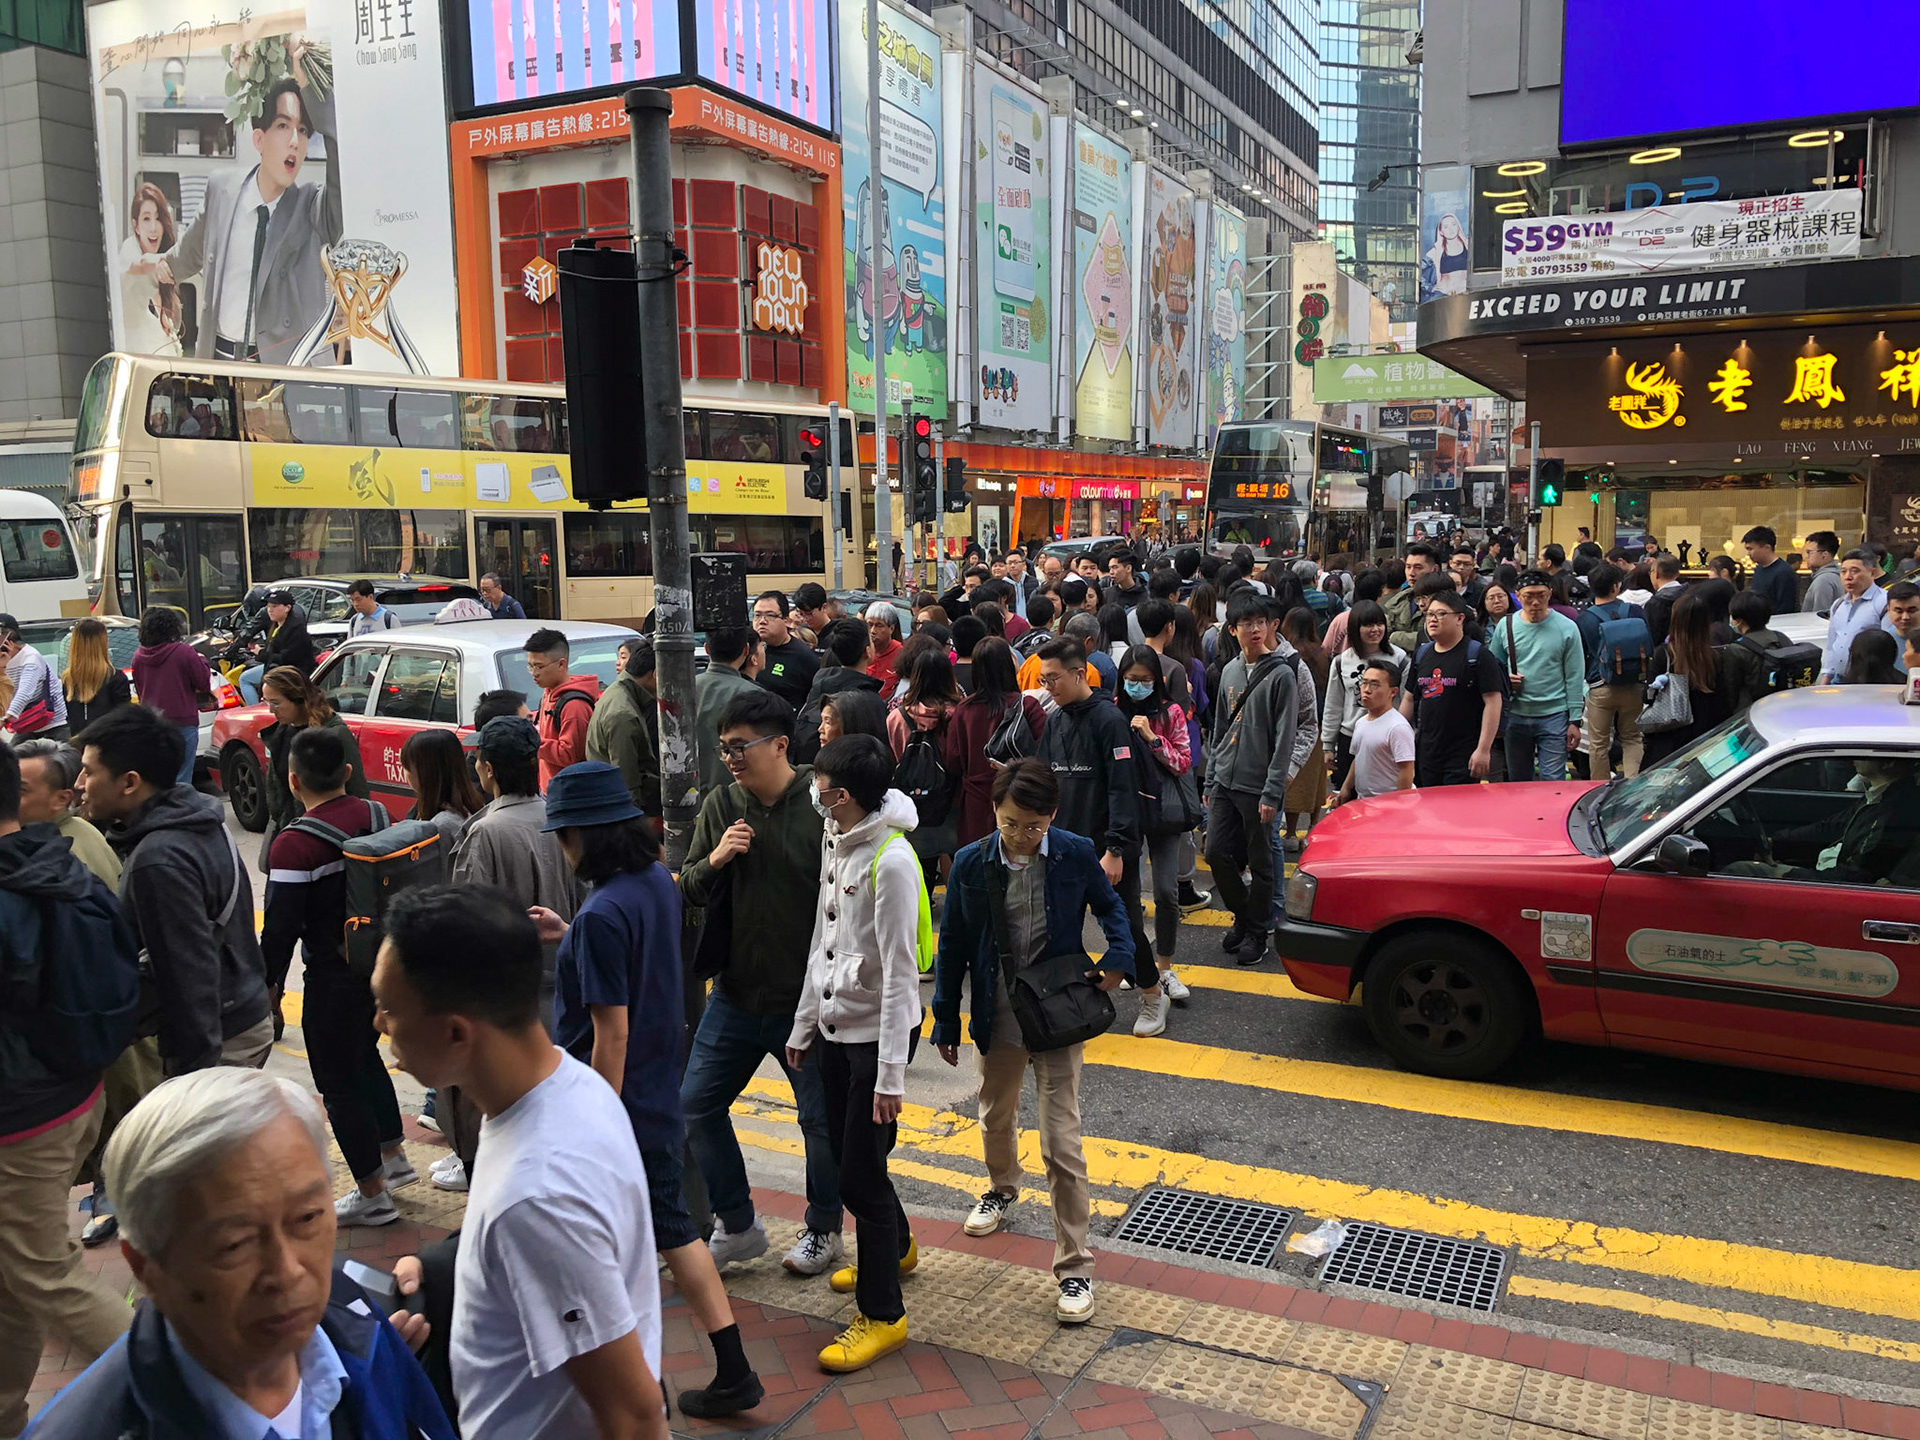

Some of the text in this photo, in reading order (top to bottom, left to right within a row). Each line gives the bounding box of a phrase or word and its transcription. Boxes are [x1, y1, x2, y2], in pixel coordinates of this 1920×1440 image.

[355, 0, 416, 45] 周生生
[356, 43, 417, 67] Chow Sang Sang
[818, 148, 836, 167] 1115
[1737, 196, 1805, 216] 現正招生
[1567, 221, 1614, 238] GYM
[1621, 226, 1685, 238] FITNESS
[1690, 211, 1857, 249] 健身器械課程
[1639, 235, 1666, 247] D2
[760, 245, 801, 282] NEW
[1504, 260, 1616, 278] 致電 36793539 預約
[523, 262, 553, 304] 新
[760, 268, 808, 307] TOWN
[1468, 279, 1746, 320] EXCEED YOUR LIMIT
[755, 298, 804, 333] MALL
[1574, 317, 1596, 326] 3679
[1599, 315, 1621, 324] 3539
[1384, 361, 1462, 382] 植物醫
[1707, 347, 1920, 411] 老鳳祥
[1737, 444, 1762, 455] LAO
[1784, 441, 1816, 454] FENG
[1832, 439, 1873, 451] XIANG
[1272, 482, 1289, 499] 16
[451, 606, 482, 618] TAXI
[1664, 944, 1727, 962] 石油氣的士
